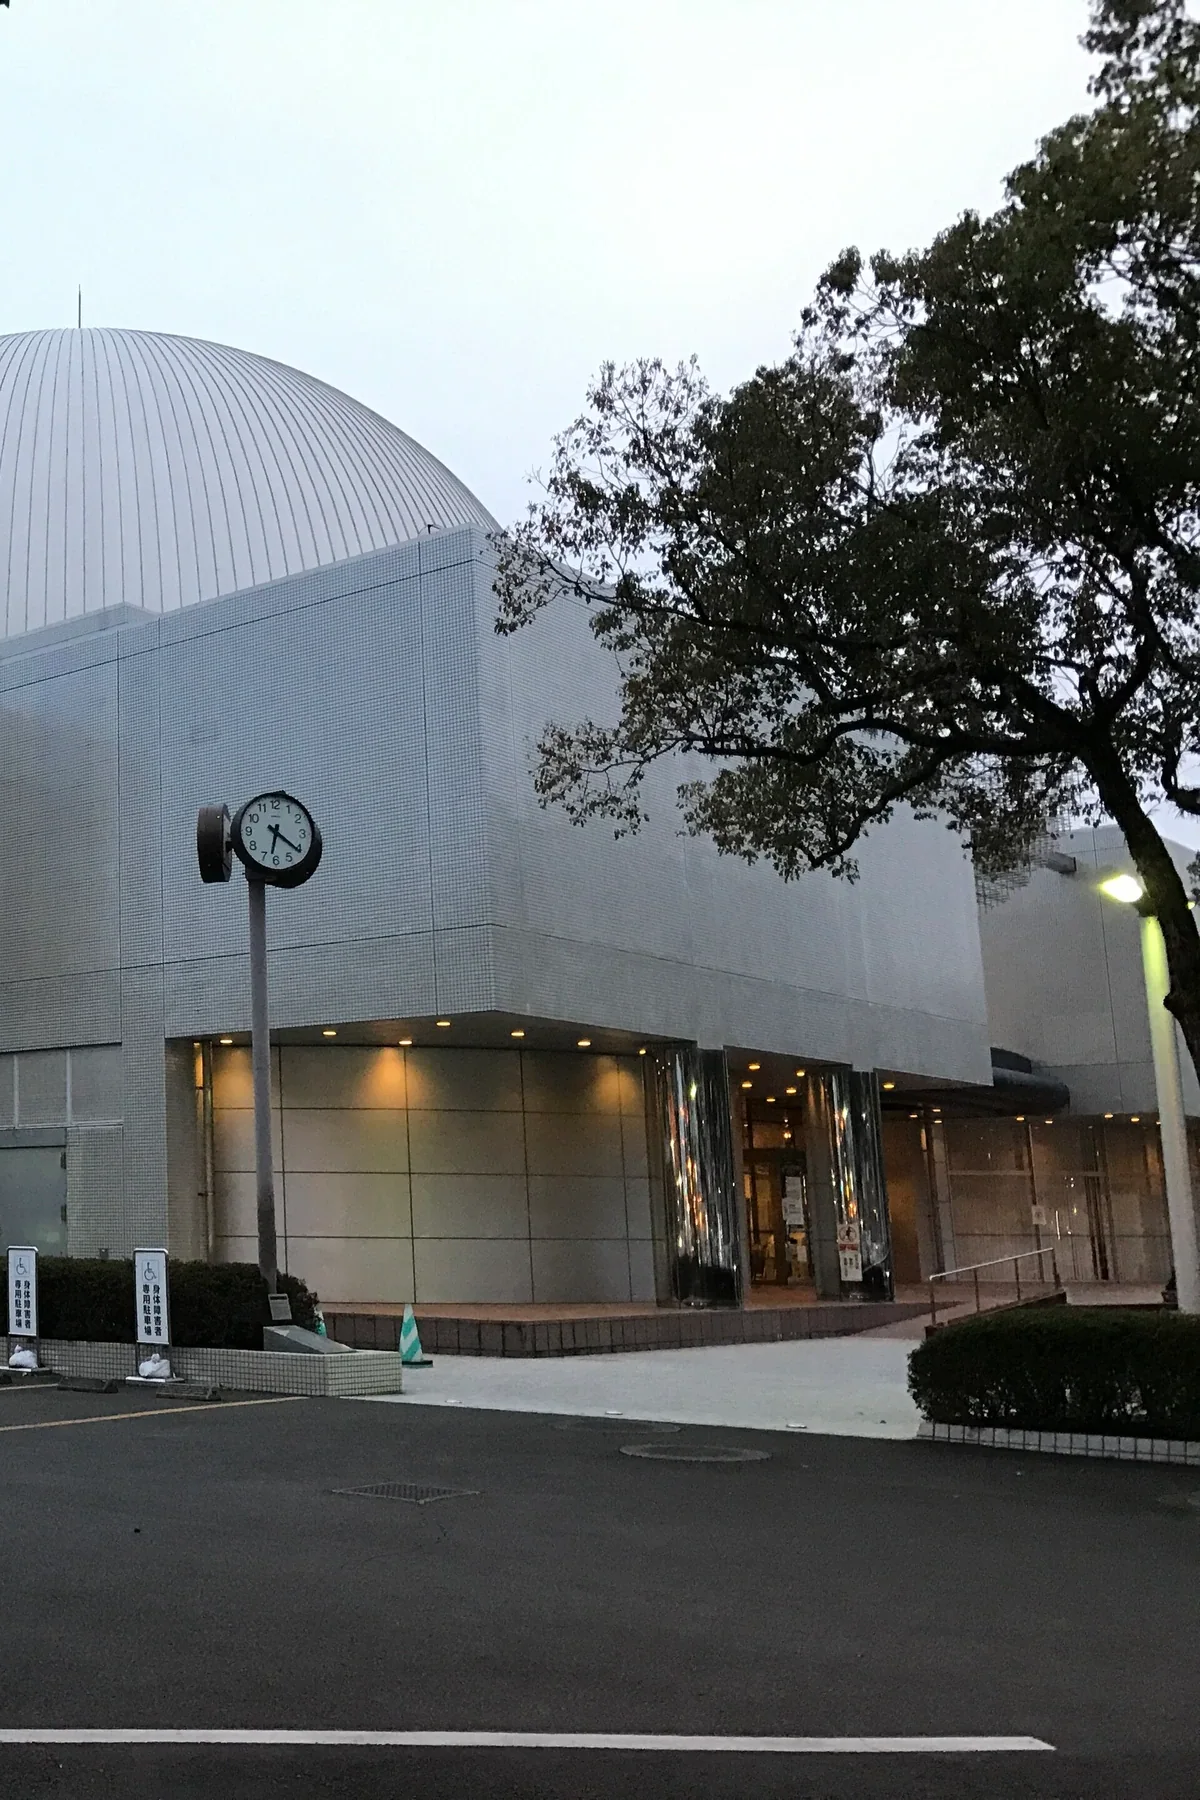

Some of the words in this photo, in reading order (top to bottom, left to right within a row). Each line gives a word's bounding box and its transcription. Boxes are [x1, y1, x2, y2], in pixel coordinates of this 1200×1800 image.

[258, 803, 267, 813] 11
[270, 800, 280, 809] 12
[249, 813, 259, 823] 10
[294, 814, 302, 824] 2
[245, 826, 253, 836] 9
[299, 829, 306, 839] 3
[249, 841, 257, 850] 8
[261, 851, 268, 861] 7
[272, 856, 280, 865] 6
[286, 852, 293, 862] 5
[143, 1284, 152, 1336] 専用駐車場
[153, 1284, 162, 1336] 身体障害者
